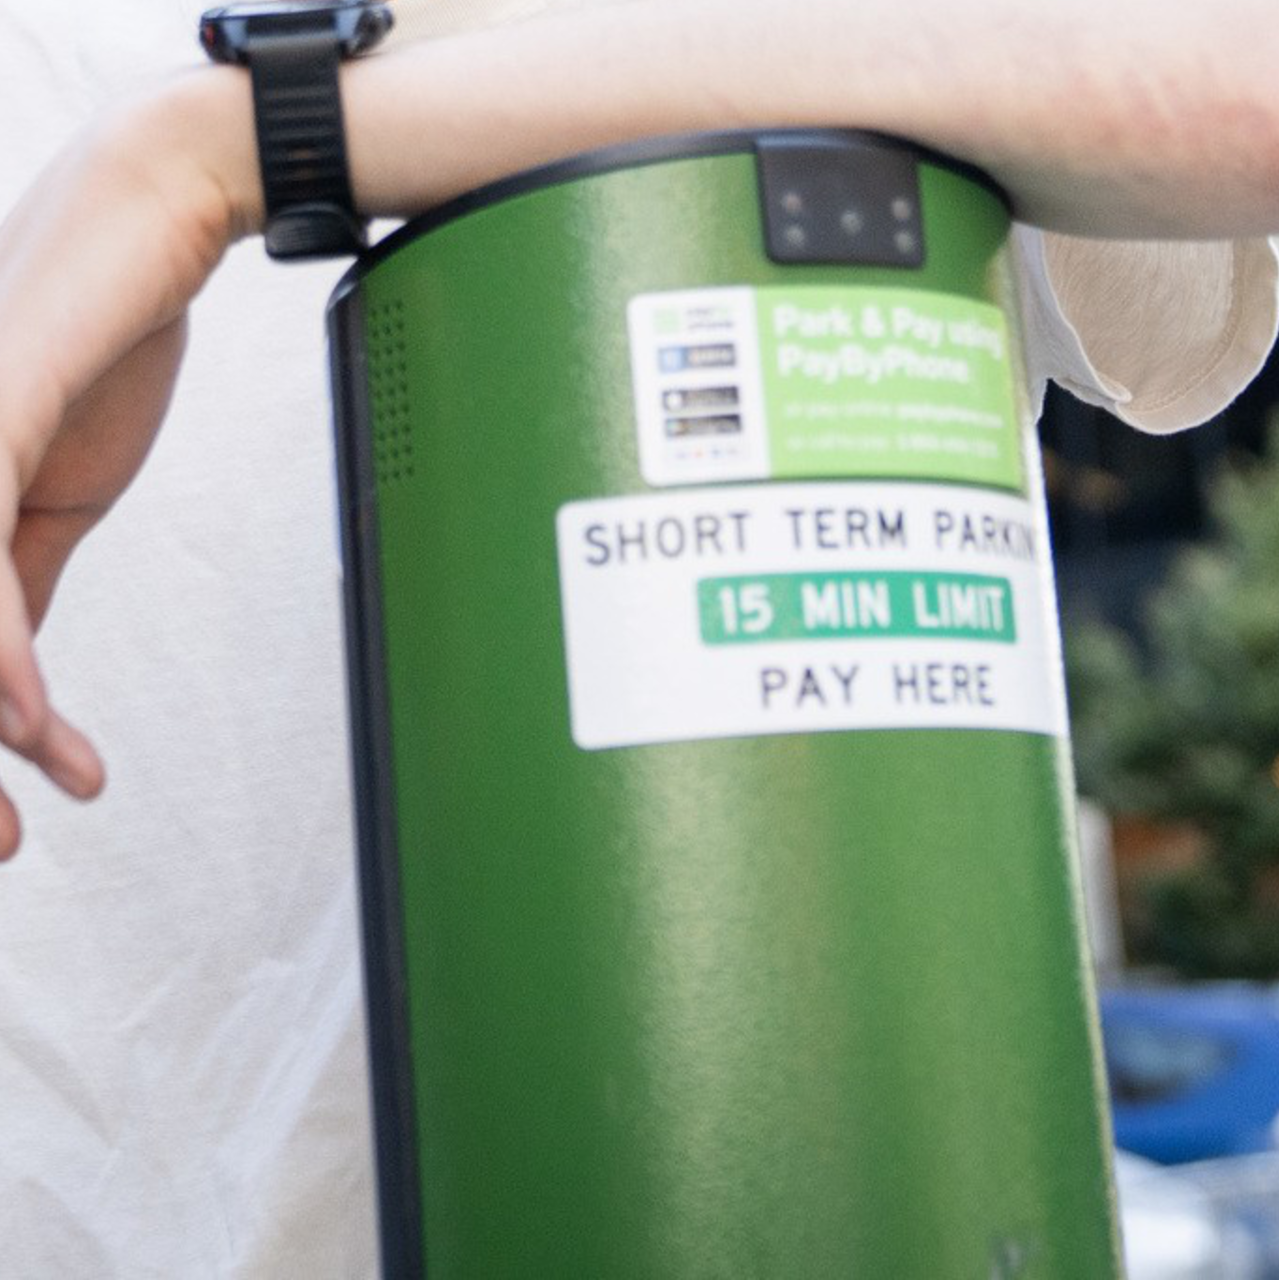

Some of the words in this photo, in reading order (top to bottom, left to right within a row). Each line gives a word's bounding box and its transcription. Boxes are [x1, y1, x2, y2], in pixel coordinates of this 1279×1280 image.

[773, 304, 853, 338] Park
[862, 304, 885, 338] &
[892, 305, 944, 348] Pay
[947, 320, 1002, 360] using
[777, 344, 969, 384] PayByPhone
[585, 512, 749, 566] SHORT
[786, 509, 907, 551] TERM
[934, 510, 1037, 561] PARKIN
[720, 581, 774, 635] 15
[801, 579, 890, 631] MIN
[912, 579, 1006, 632] LIMIT
[760, 665, 859, 709] PAY
[894, 663, 995, 706] HERE
